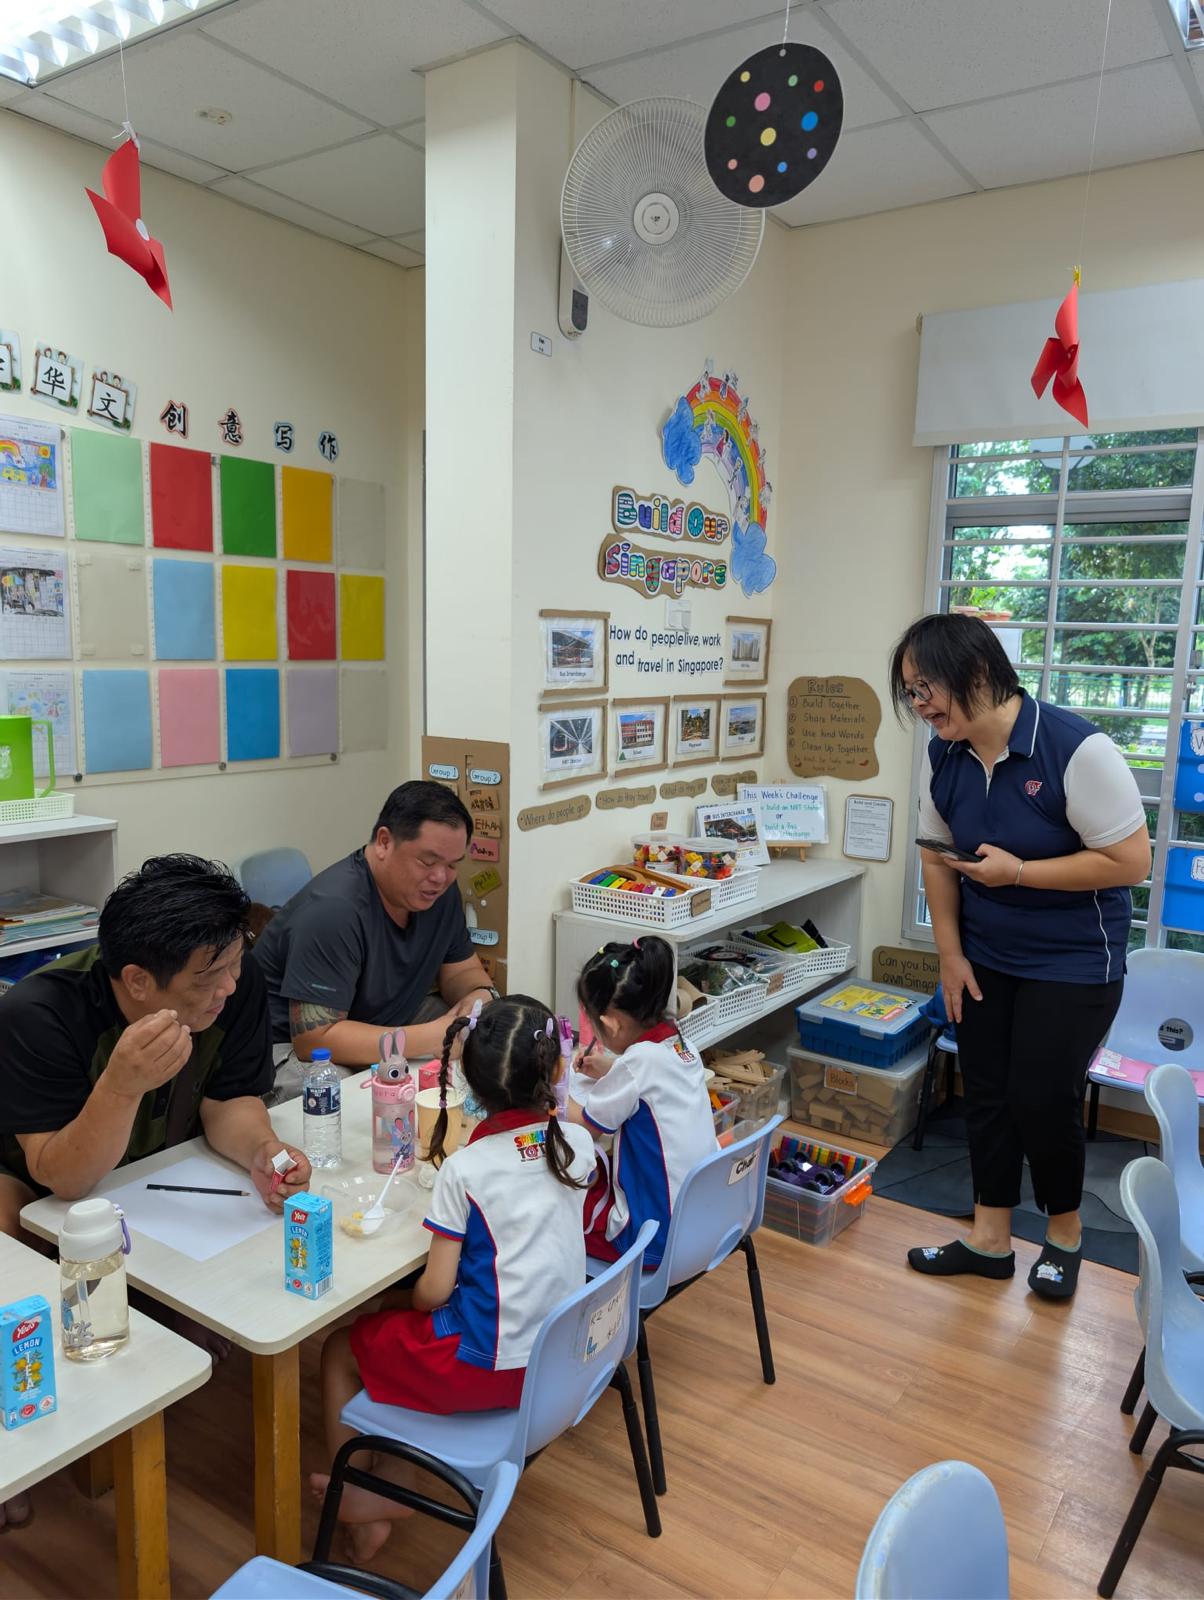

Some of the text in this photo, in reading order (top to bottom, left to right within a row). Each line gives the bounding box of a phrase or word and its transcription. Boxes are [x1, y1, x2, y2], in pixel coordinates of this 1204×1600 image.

[161, 402, 338, 461] 创意写作
[616, 492, 728, 541] Build Our
[606, 542, 728, 594] Singapore
[609, 625, 631, 641] How
[634, 625, 649, 641] do
[651, 631, 684, 649] people
[702, 634, 721, 647] work
[616, 651, 635, 666] and
[637, 658, 664, 673] travel
[666, 658, 675, 673] in
[678, 656, 724, 676] Singapore?
[808, 680, 844, 694] Rules
[803, 698, 823, 708] Build
[829, 699, 861, 713] Together
[802, 713, 825, 724] Share
[802, 728, 815, 738] Use
[839, 730, 864, 739] Words
[802, 740, 822, 751] Clean
[838, 744, 868, 757] Together
[431, 765, 451, 779] Group
[472, 770, 498, 784] Group 2
[743, 789, 757, 801] This
[786, 791, 819, 804] Challenge
[524, 813, 545, 827] Where
[721, 809, 746, 819] INTERCHANGE
[878, 950, 898, 967] Can
[901, 960, 919, 973] you
[883, 973, 903, 985] own
[14, 1337, 40, 1356] LEMON
[24, 1350, 34, 1390] TEA
